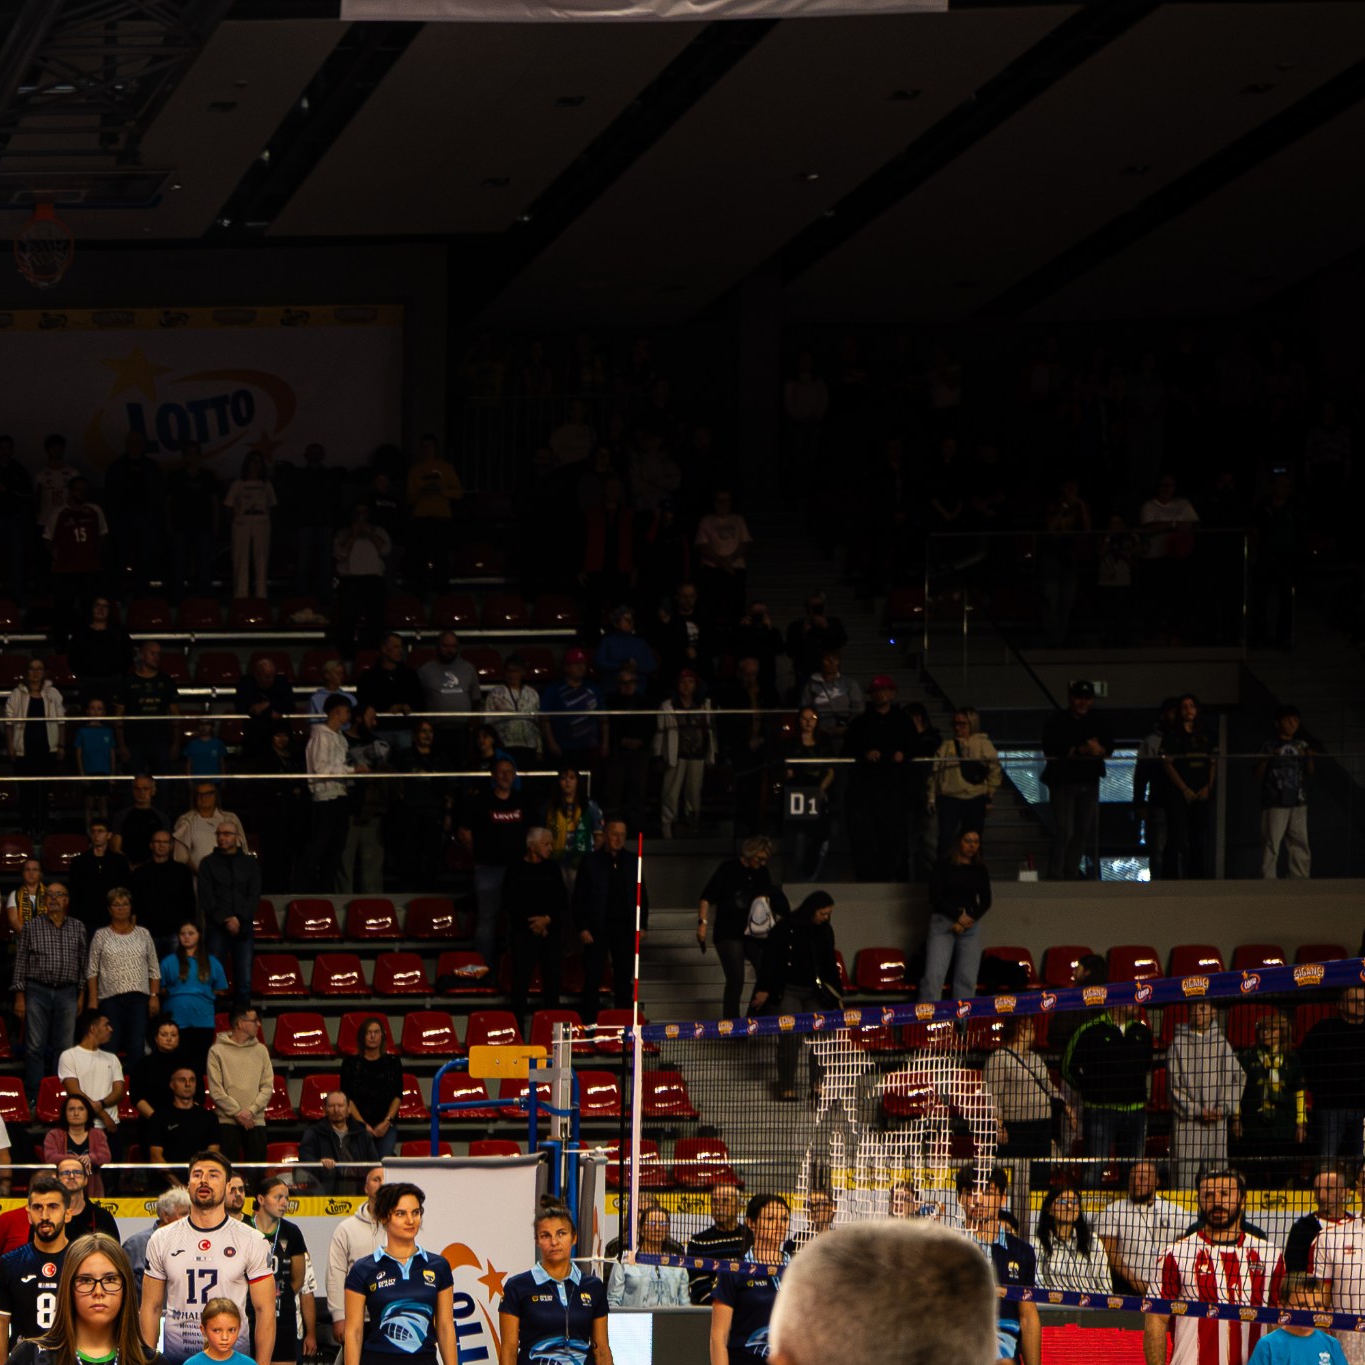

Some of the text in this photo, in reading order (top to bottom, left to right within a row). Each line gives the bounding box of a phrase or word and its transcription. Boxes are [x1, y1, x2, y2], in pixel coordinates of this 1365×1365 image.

[126, 390, 255, 454] LOTTO
[790, 792, 818, 815] D1
[185, 1269, 217, 1304] 17
[37, 1292, 57, 1329] 8
